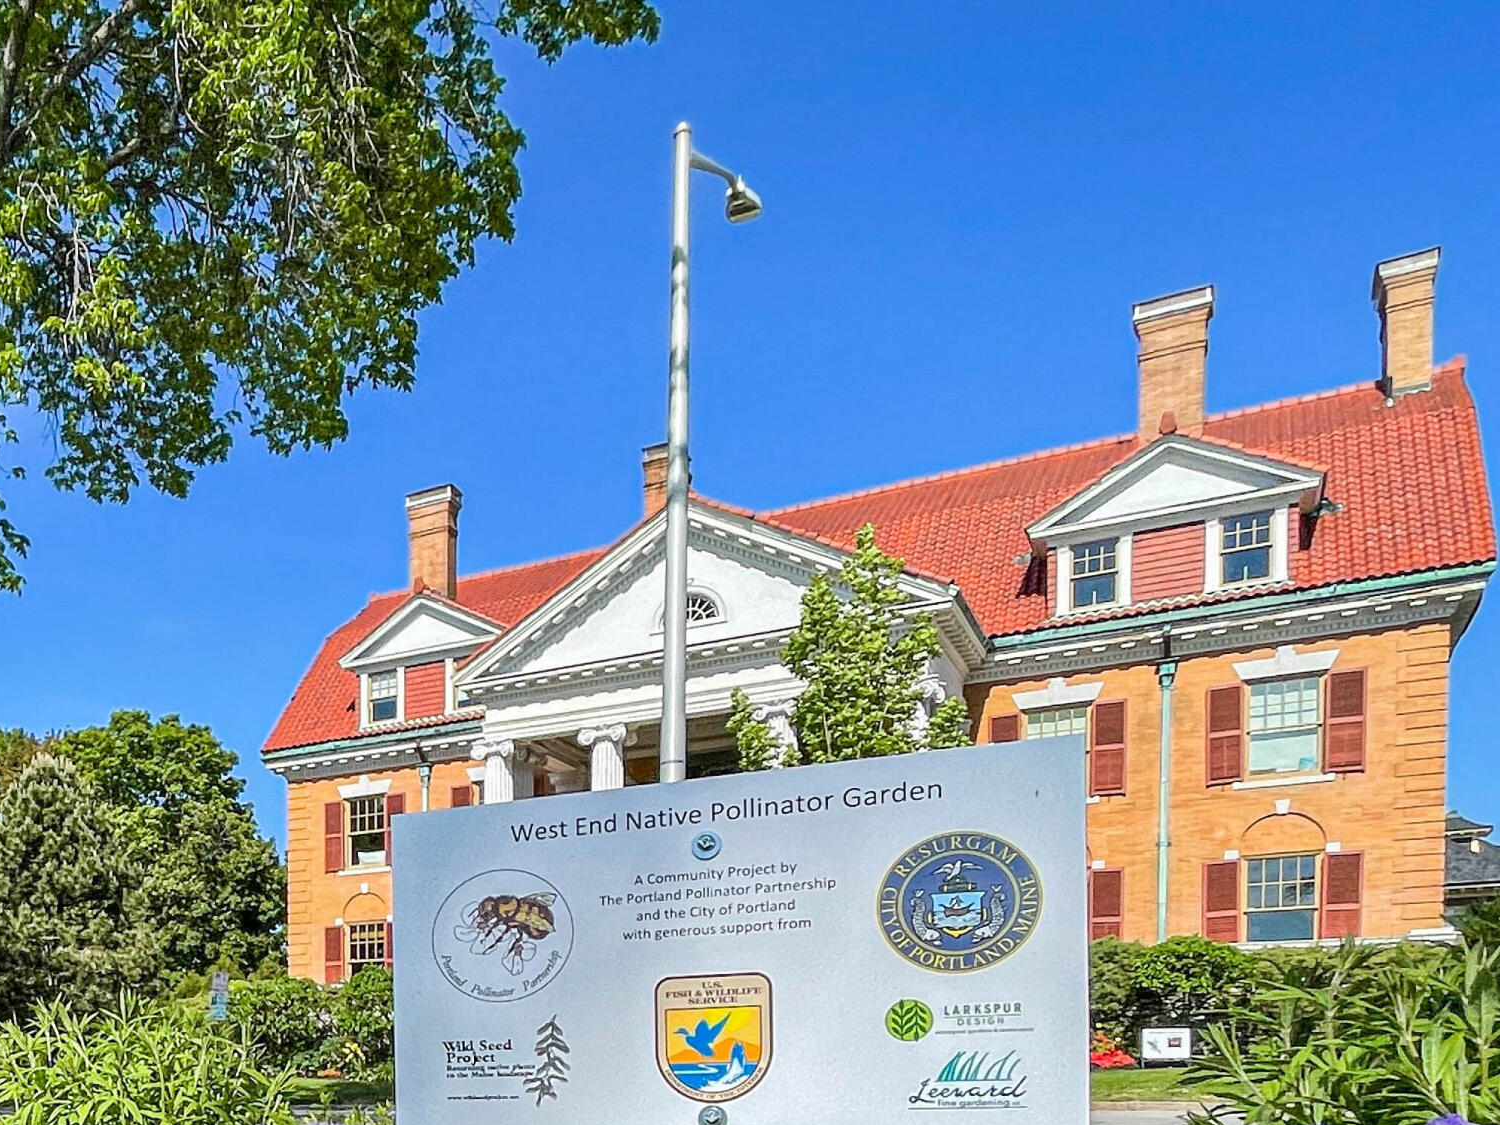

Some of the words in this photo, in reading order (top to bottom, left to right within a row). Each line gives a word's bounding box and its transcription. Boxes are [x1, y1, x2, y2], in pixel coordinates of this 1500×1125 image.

[510, 821, 568, 842] West
[576, 813, 617, 836] End
[626, 808, 701, 831] Native
[711, 794, 834, 822] Pollinator
[843, 781, 942, 808] Garden
[634, 875, 643, 885] A
[647, 868, 724, 885] Community
[728, 865, 776, 878] Project
[780, 861, 798, 875] by
[599, 894, 623, 906] The
[627, 889, 681, 904] Portland
[686, 884, 750, 900] Pollinator
[755, 876, 837, 894] Partnership
[636, 910, 660, 922] and
[664, 908, 686, 919] the
[690, 905, 715, 919] City
[719, 903, 733, 915] of
[737, 899, 796, 913] Portland
[881, 887, 900, 927] CITY
[1011, 874, 1038, 935] MAINE
[623, 928, 651, 941] with
[655, 925, 716, 941] generous
[720, 920, 773, 935] support
[777, 917, 811, 930] from
[889, 929, 912, 948] OF
[665, 990, 692, 998] FISH
[705, 987, 762, 996] WILDLIFE
[702, 981, 723, 989] U.S.
[688, 996, 738, 1004] SERVICE
[944, 1003, 1022, 1016] LARKSPUR
[957, 1017, 1004, 1026] DESIGN
[442, 1040, 474, 1052] Wild
[480, 1039, 513, 1051] Seed
[447, 1052, 495, 1066] Project
[959, 1099, 1010, 1107] gardening
